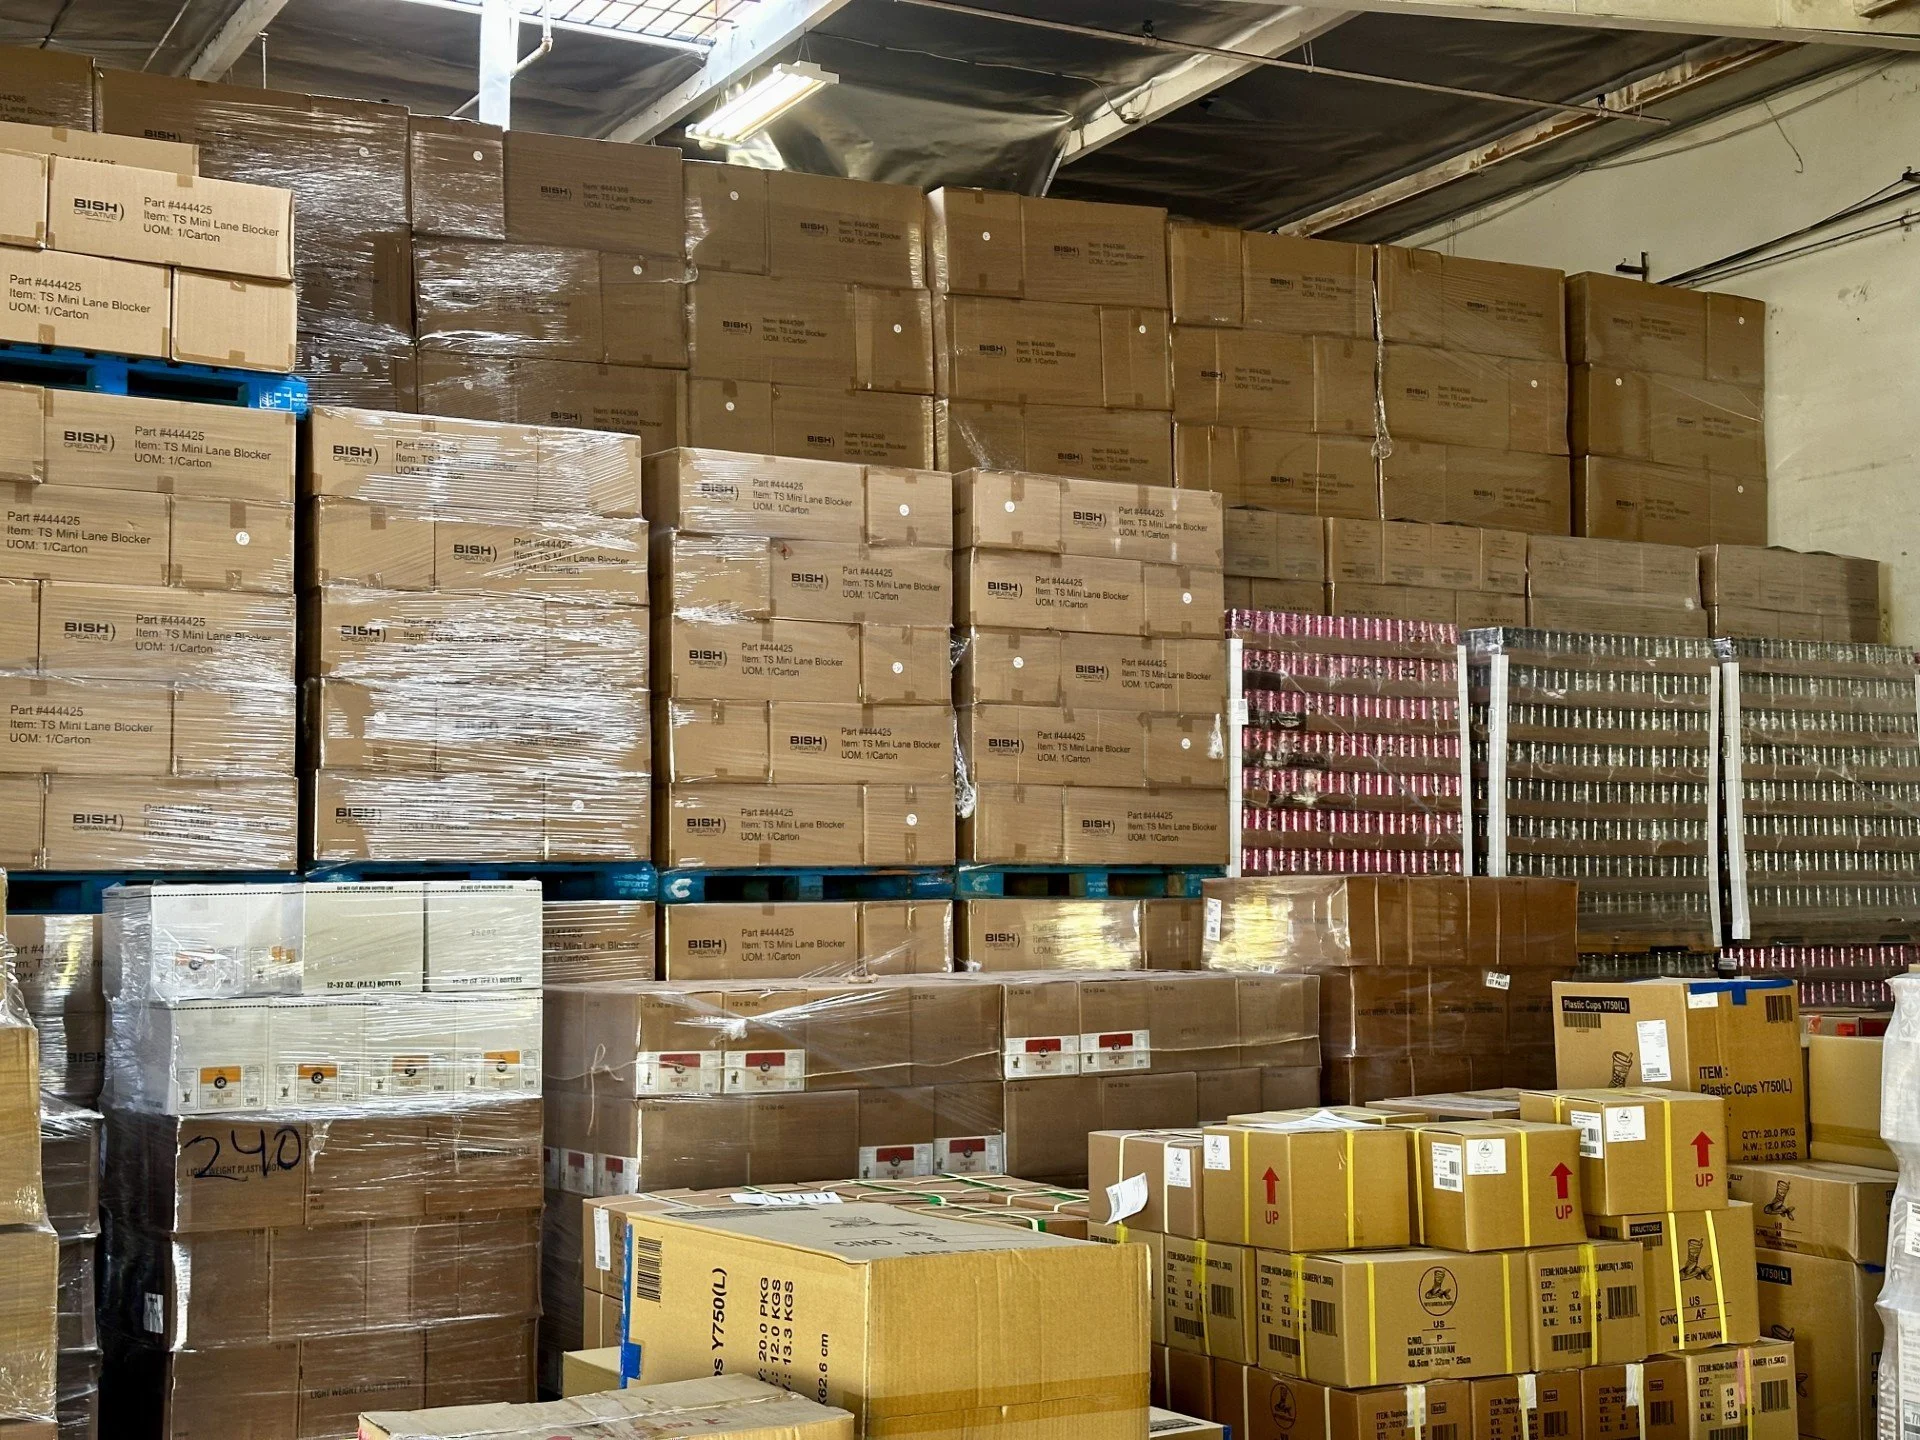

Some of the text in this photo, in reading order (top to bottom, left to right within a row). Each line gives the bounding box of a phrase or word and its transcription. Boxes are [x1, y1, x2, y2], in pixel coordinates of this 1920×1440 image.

[144, 197, 212, 214] Part #444425
[74, 210, 117, 220] CREATIVE
[144, 211, 279, 236] Item: TS Mini Lane Blocker
[144, 224, 220, 242] UOM: 1/Carton
[10, 275, 81, 292] Part #444425
[10, 289, 150, 313] Item: TS Mini Lane Blocker
[10, 302, 88, 319] UOM: 1/Carton
[135, 426, 204, 441] Part #444425
[64, 442, 107, 451] CREATIVE
[135, 441, 271, 460] Item: TS Mini Lane Blocker
[135, 454, 211, 468] UOM: 1/Carton
[843, 566, 892, 577] Part #444425
[843, 578, 940, 592] Item: TS Mini Lane Blocker
[1036, 576, 1082, 586] Part #444425
[843, 590, 898, 601] UOM: 1/Carton
[1055, 588, 1065, 596] TS
[1067, 589, 1081, 597] Mini
[1083, 590, 1100, 598] Lane
[1103, 592, 1129, 600] Blocker
[1059, 600, 1088, 608] 1/Carton
[842, 727, 891, 737] Part #444425
[842, 740, 940, 750] Item: TS Mini Lane Blocker
[866, 752, 897, 760] 1/Carton
[378, 980, 401, 988] BOTTLES
[1584, 1001, 1600, 1011] Cups
[1602, 1000, 1628, 1011] Y750(L)
[1699, 1066, 1722, 1079] ITEM
[1701, 1079, 1792, 1097] Plastic Cups Y750(L)
[1764, 1129, 1778, 1138] 20.0
[1781, 1128, 1795, 1136] PKG
[1765, 1141, 1778, 1149] 12.0
[1781, 1140, 1796, 1148] KGS
[184, 1125, 301, 1182] 240
[1696, 1174, 1713, 1187] UP
[1265, 1211, 1279, 1224] UP
[1556, 1205, 1572, 1219] UP
[1631, 1224, 1661, 1233] FRUCTOSE
[760, 1277, 768, 1316] PKG
[1572, 1291, 1579, 1299] 12
[1689, 1296, 1700, 1305] US
[712, 1268, 727, 1350] Y750(L)
[1696, 1309, 1706, 1319] AF
[770, 1279, 781, 1363] 12.0 KGS
[783, 1281, 793, 1364] 13.3 KGS
[1570, 1316, 1582, 1324] 16.5
[1691, 1331, 1722, 1341] IN TAIWAN
[759, 1323, 767, 1362] 20.0
[821, 1334, 828, 1357] cm
[1408, 1348, 1424, 1356] MADE
[1426, 1347, 1431, 1355] IN
[1726, 1388, 1733, 1396] 10
[1727, 1400, 1734, 1408] 15
[1724, 1411, 1738, 1420] 15.9
